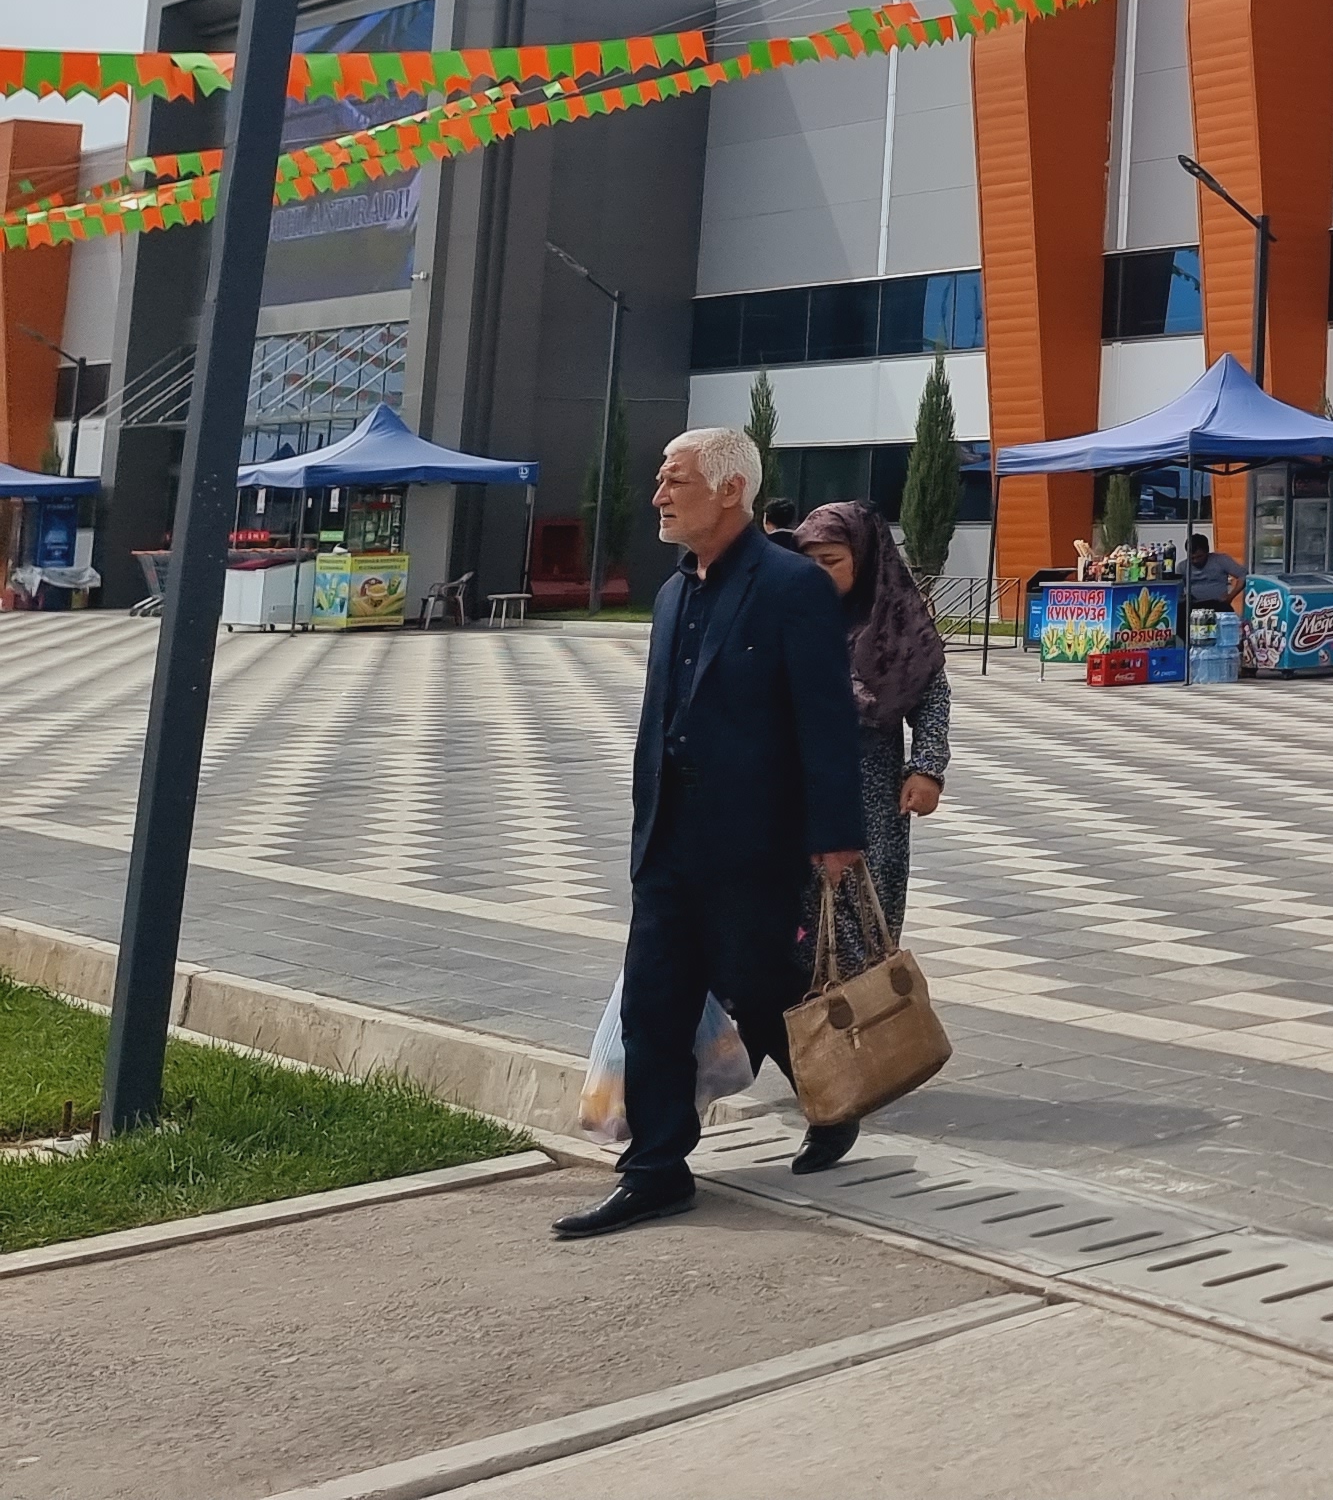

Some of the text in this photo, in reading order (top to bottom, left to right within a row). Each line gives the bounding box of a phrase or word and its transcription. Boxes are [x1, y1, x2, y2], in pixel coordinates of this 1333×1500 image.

[1049, 589, 1105, 604] ГОРЯЧАЯ
[1047, 606, 1106, 621] КУКУРУЗА
[1114, 629, 1172, 643] ГОРЯЧАЯ
